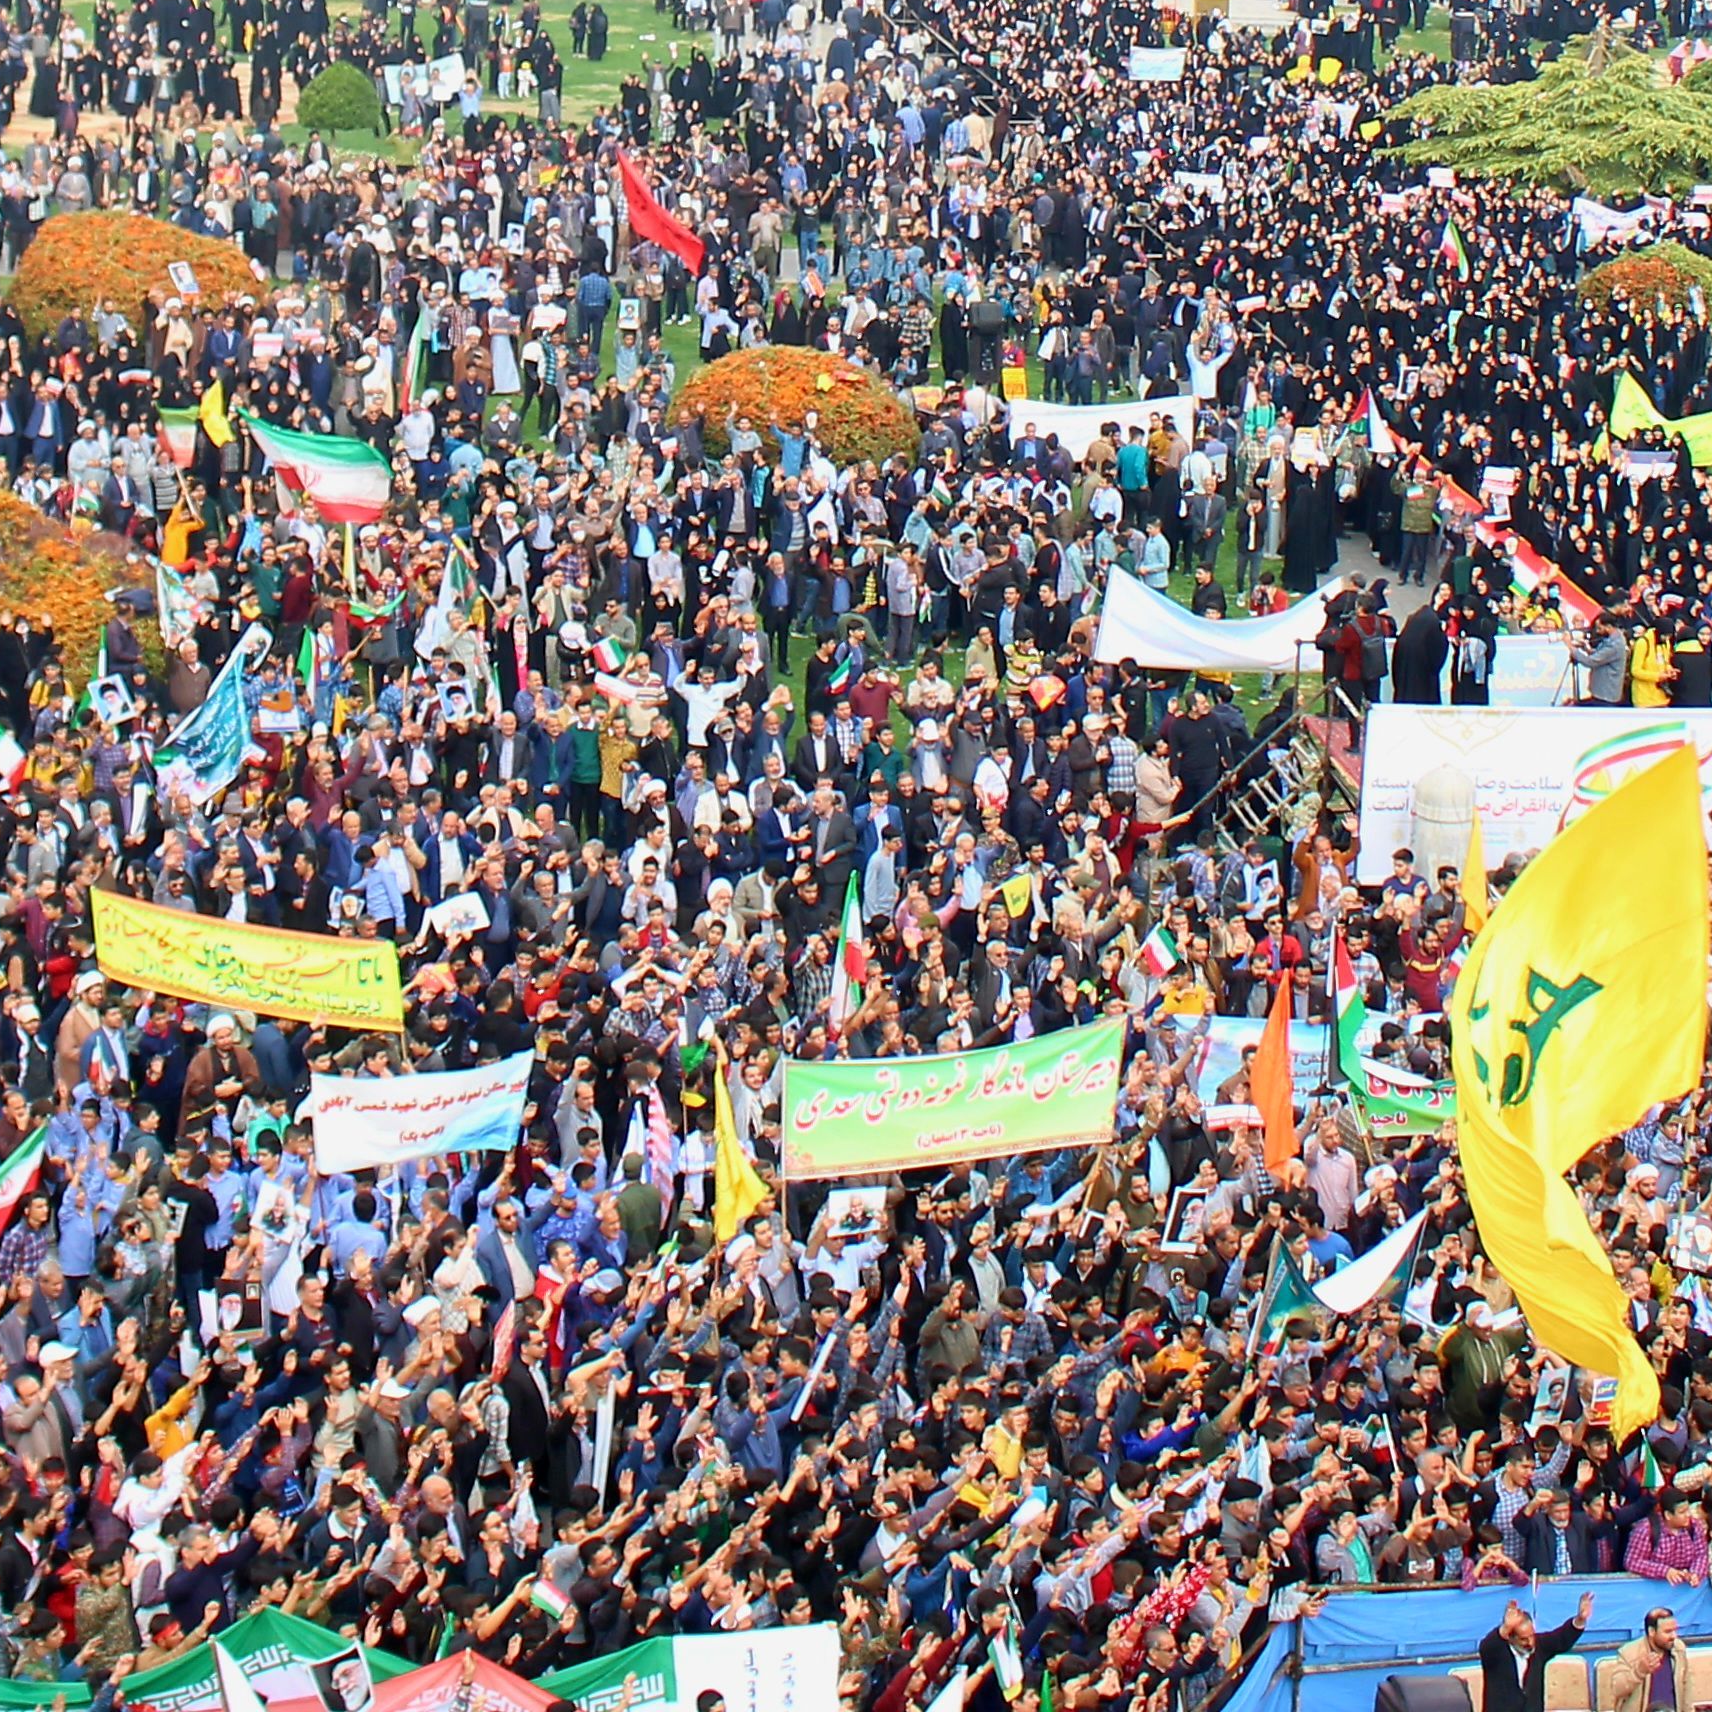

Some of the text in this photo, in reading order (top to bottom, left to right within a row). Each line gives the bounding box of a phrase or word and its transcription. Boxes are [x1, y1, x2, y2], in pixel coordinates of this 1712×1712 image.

[793, 1049, 1117, 1129] دبیرستان ماندگار نمونه دولتی سعدی
